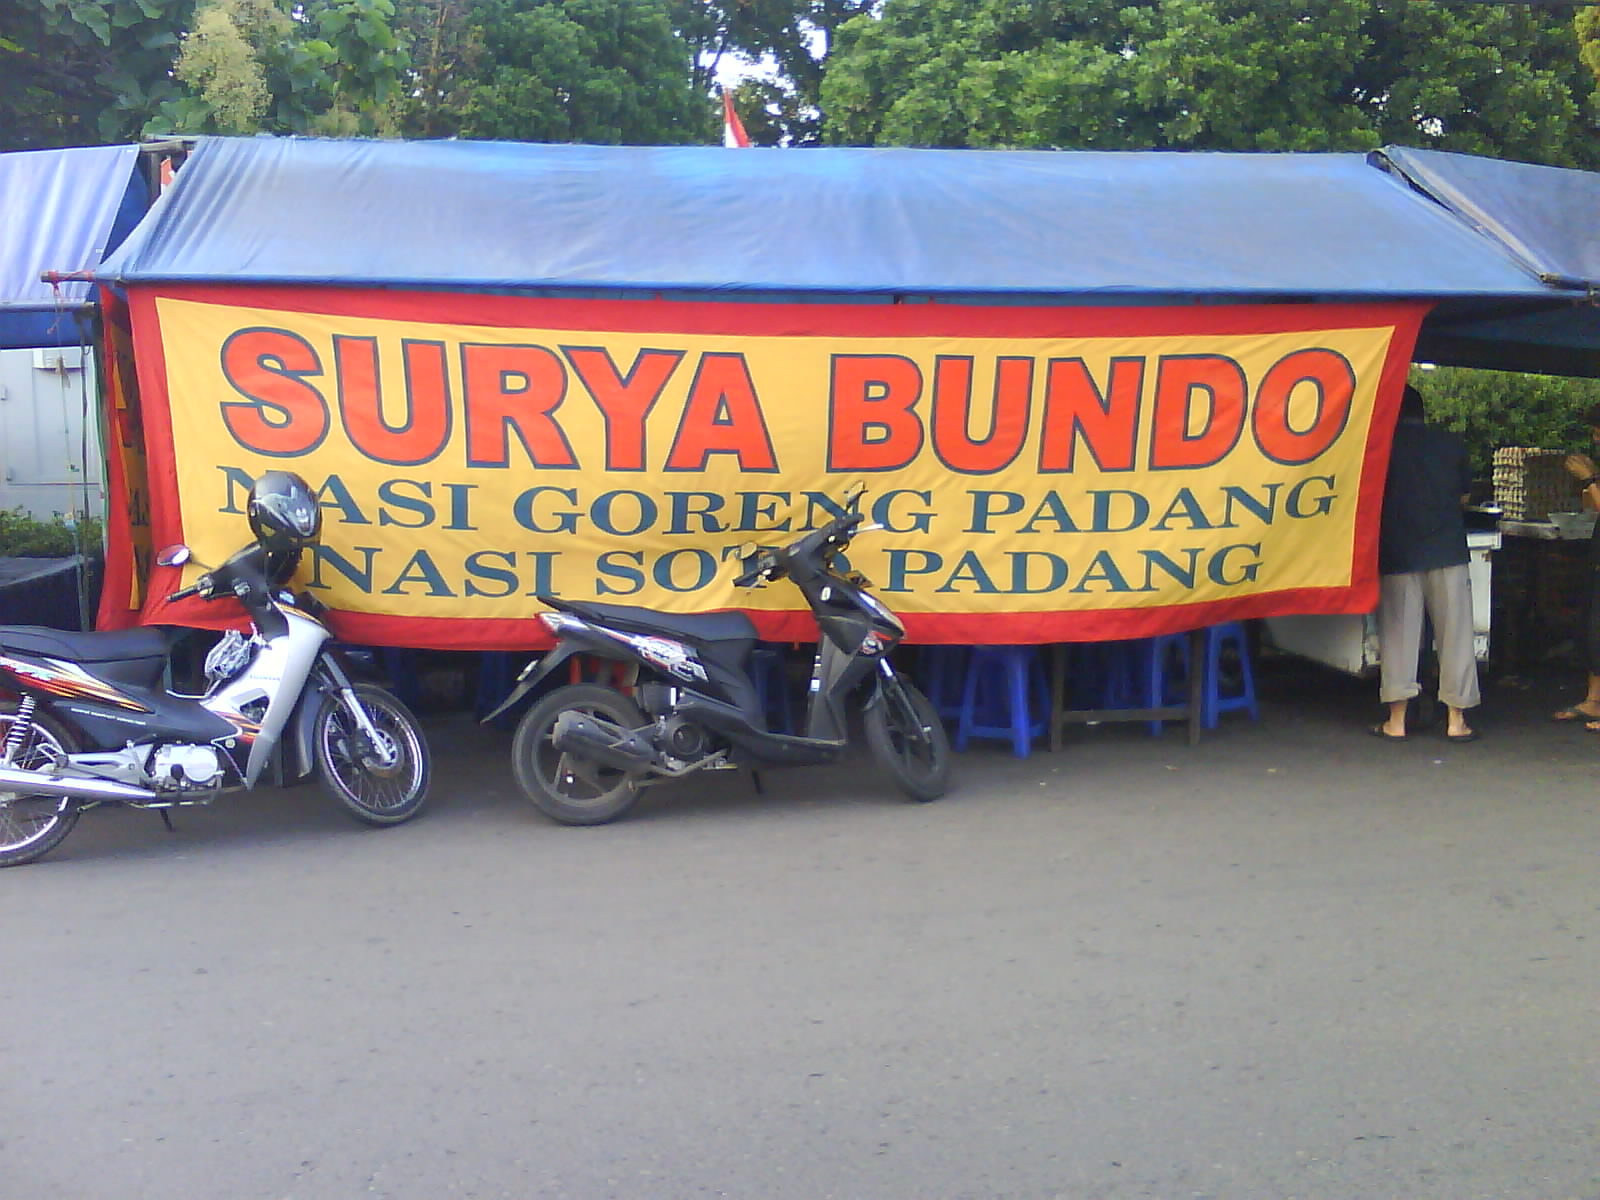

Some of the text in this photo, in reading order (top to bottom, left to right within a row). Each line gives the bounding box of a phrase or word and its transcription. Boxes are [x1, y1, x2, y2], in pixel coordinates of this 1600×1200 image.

[219, 326, 1357, 475] SURYA BUNDO
[513, 485, 939, 536] GORENG
[962, 474, 1338, 534] PADANG
[302, 541, 1264, 599] NASI SOT PADANG
